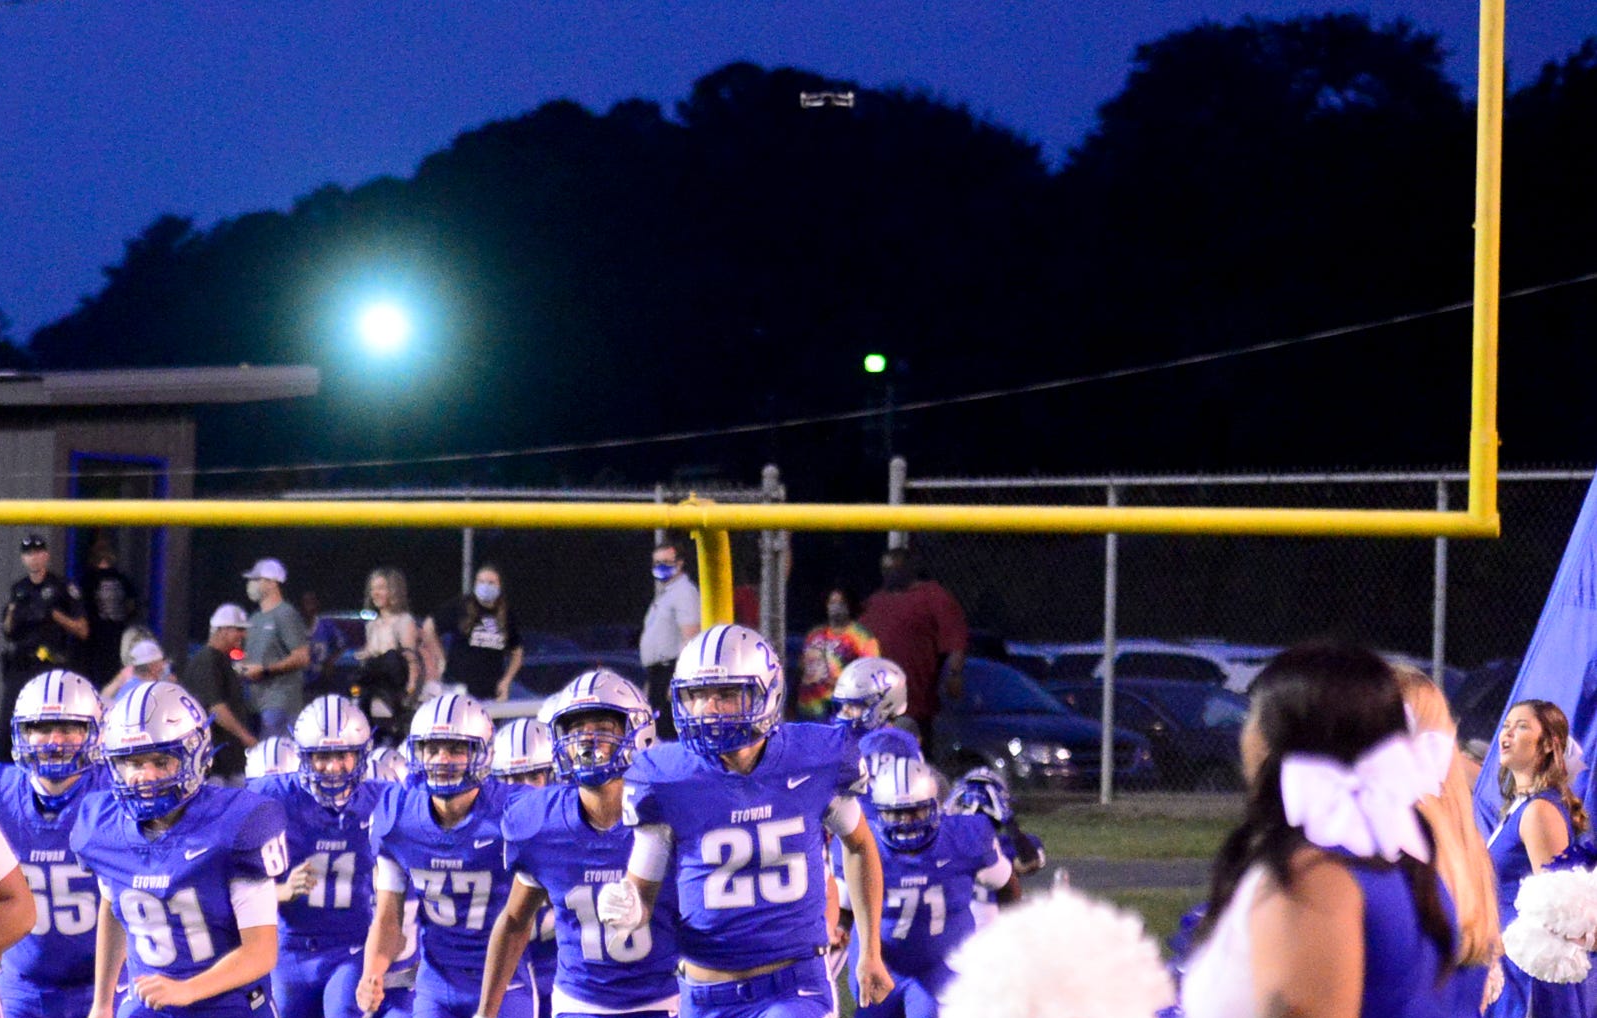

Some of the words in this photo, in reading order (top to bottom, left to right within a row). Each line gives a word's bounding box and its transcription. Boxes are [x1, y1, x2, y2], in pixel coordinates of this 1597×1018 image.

[730, 804, 773, 825] ETOWAH
[30, 848, 66, 863] ETOWAH
[260, 830, 290, 878] 81
[315, 838, 348, 852] ETOWAH
[429, 857, 464, 872] ETOWAH
[701, 816, 809, 911] 25
[131, 874, 171, 891] ETOWAH
[304, 852, 356, 909] 11
[583, 869, 624, 884] ETOWAH
[20, 862, 98, 936] 65
[886, 884, 947, 940] 71
